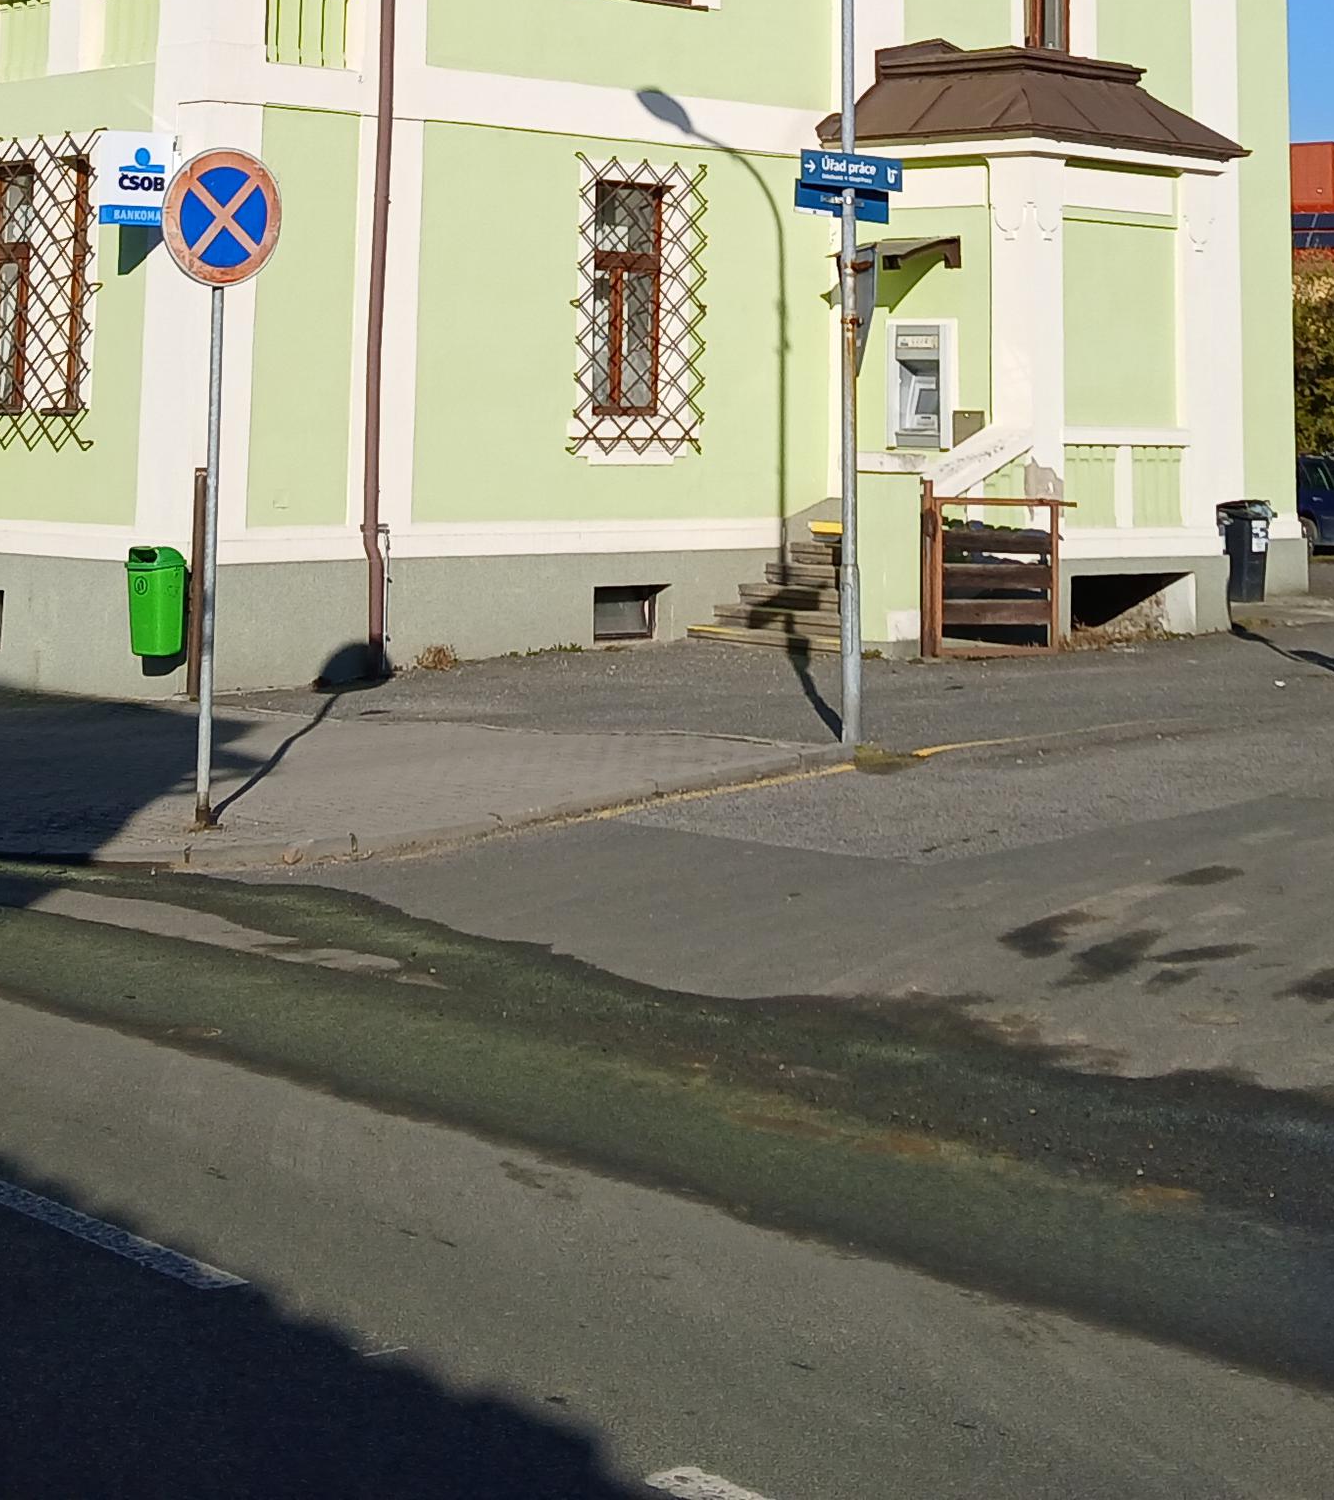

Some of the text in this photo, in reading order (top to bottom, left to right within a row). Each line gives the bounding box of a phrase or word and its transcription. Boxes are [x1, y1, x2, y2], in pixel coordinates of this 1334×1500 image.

[821, 155, 877, 175] Úřad práce
[118, 173, 165, 191] ČSOB
[113, 210, 161, 221] BANKOMA
